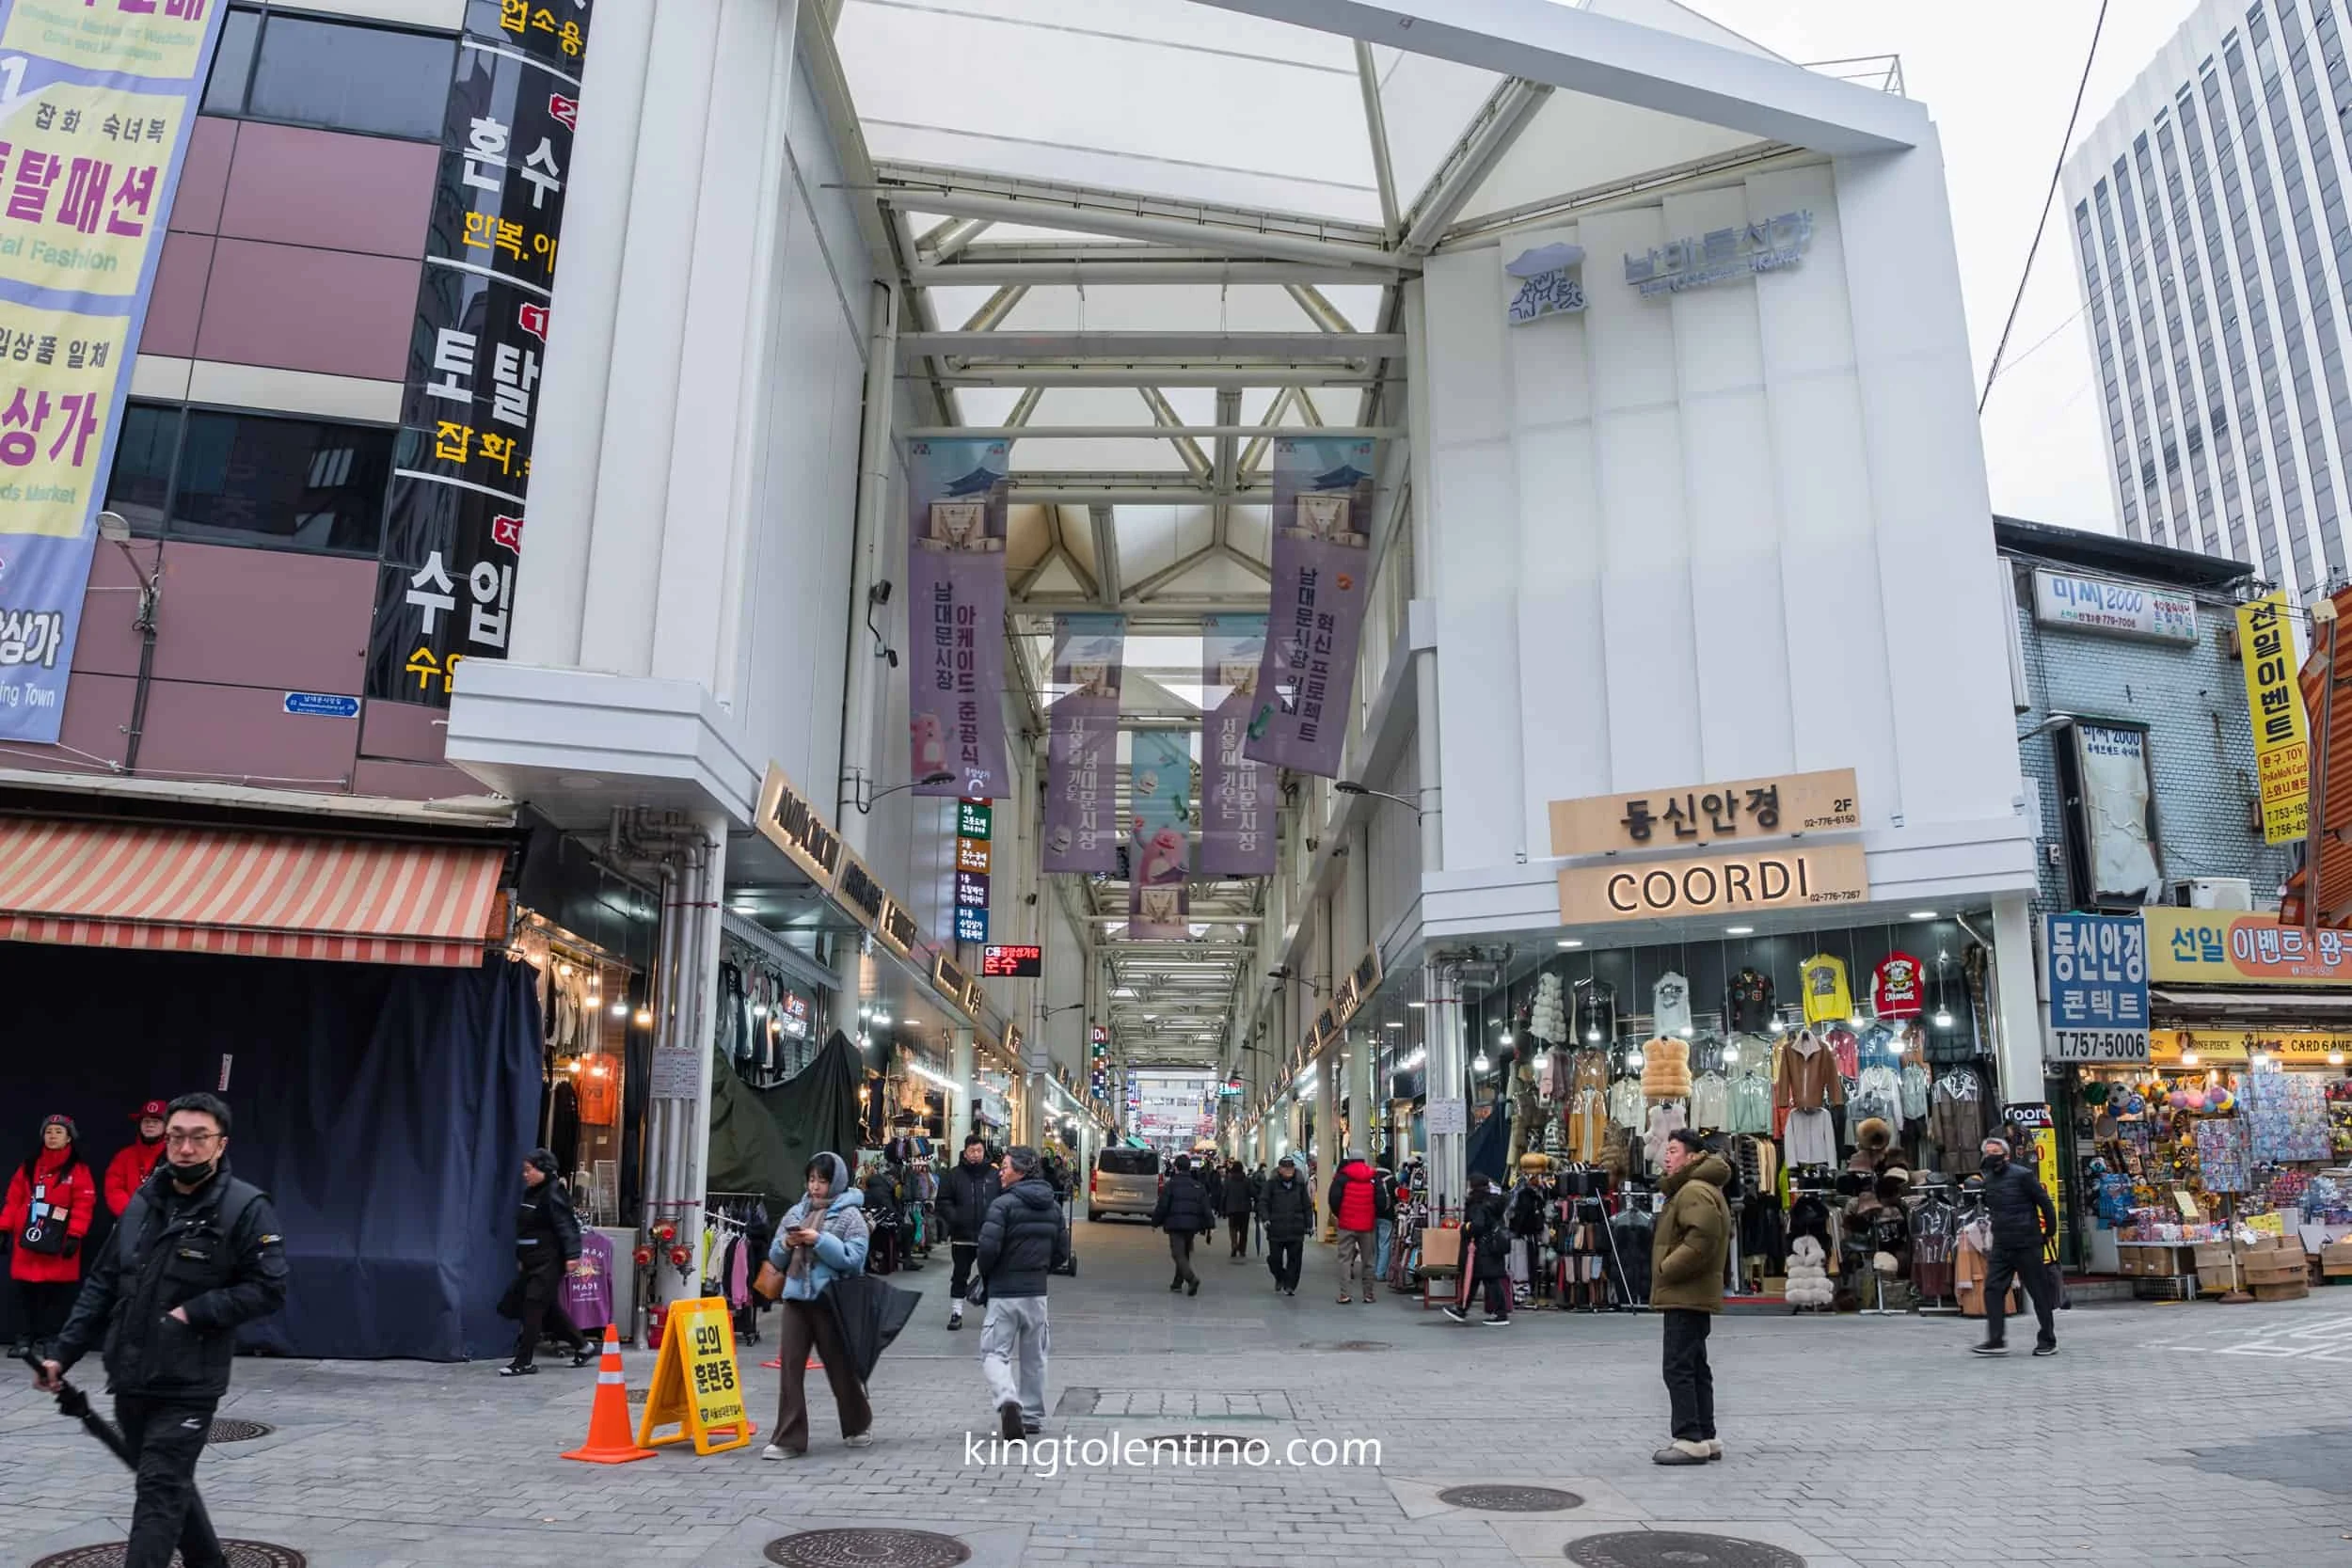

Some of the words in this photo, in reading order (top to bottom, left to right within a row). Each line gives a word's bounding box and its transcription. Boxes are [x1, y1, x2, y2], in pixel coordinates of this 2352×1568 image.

[36, 102, 82, 134] 잡화
[103, 113, 167, 143] 숙녀복
[462, 116, 561, 210] 혼수
[0, 141, 158, 237] 탈패션
[30, 240, 118, 272] Fashion
[67, 340, 109, 369] 일체
[426, 327, 540, 429] 토탈
[406, 550, 513, 648] 수입
[0, 610, 63, 670] 상가
[933, 580, 955, 692] 남대문시장
[957, 605, 977, 694] 아케이드
[2249, 598, 2295, 744] 선일이벤트
[25, 682, 56, 708] Town
[1620, 784, 1785, 841] 동신안경
[1833, 799, 1853, 814] 2F
[1607, 857, 1808, 912] COORDI
[984, 957, 1018, 975] 준수
[2052, 922, 2144, 984] 동신안경
[2170, 926, 2225, 963] 선일
[2233, 926, 2306, 965] 이벤트
[2062, 990, 2141, 1022] 콘택트
[2056, 1033, 2146, 1060] T.757-5006
[2291, 1038, 2320, 1053] CARD
[695, 1325, 723, 1355] 모의
[694, 1359, 735, 1394] 훈련중
